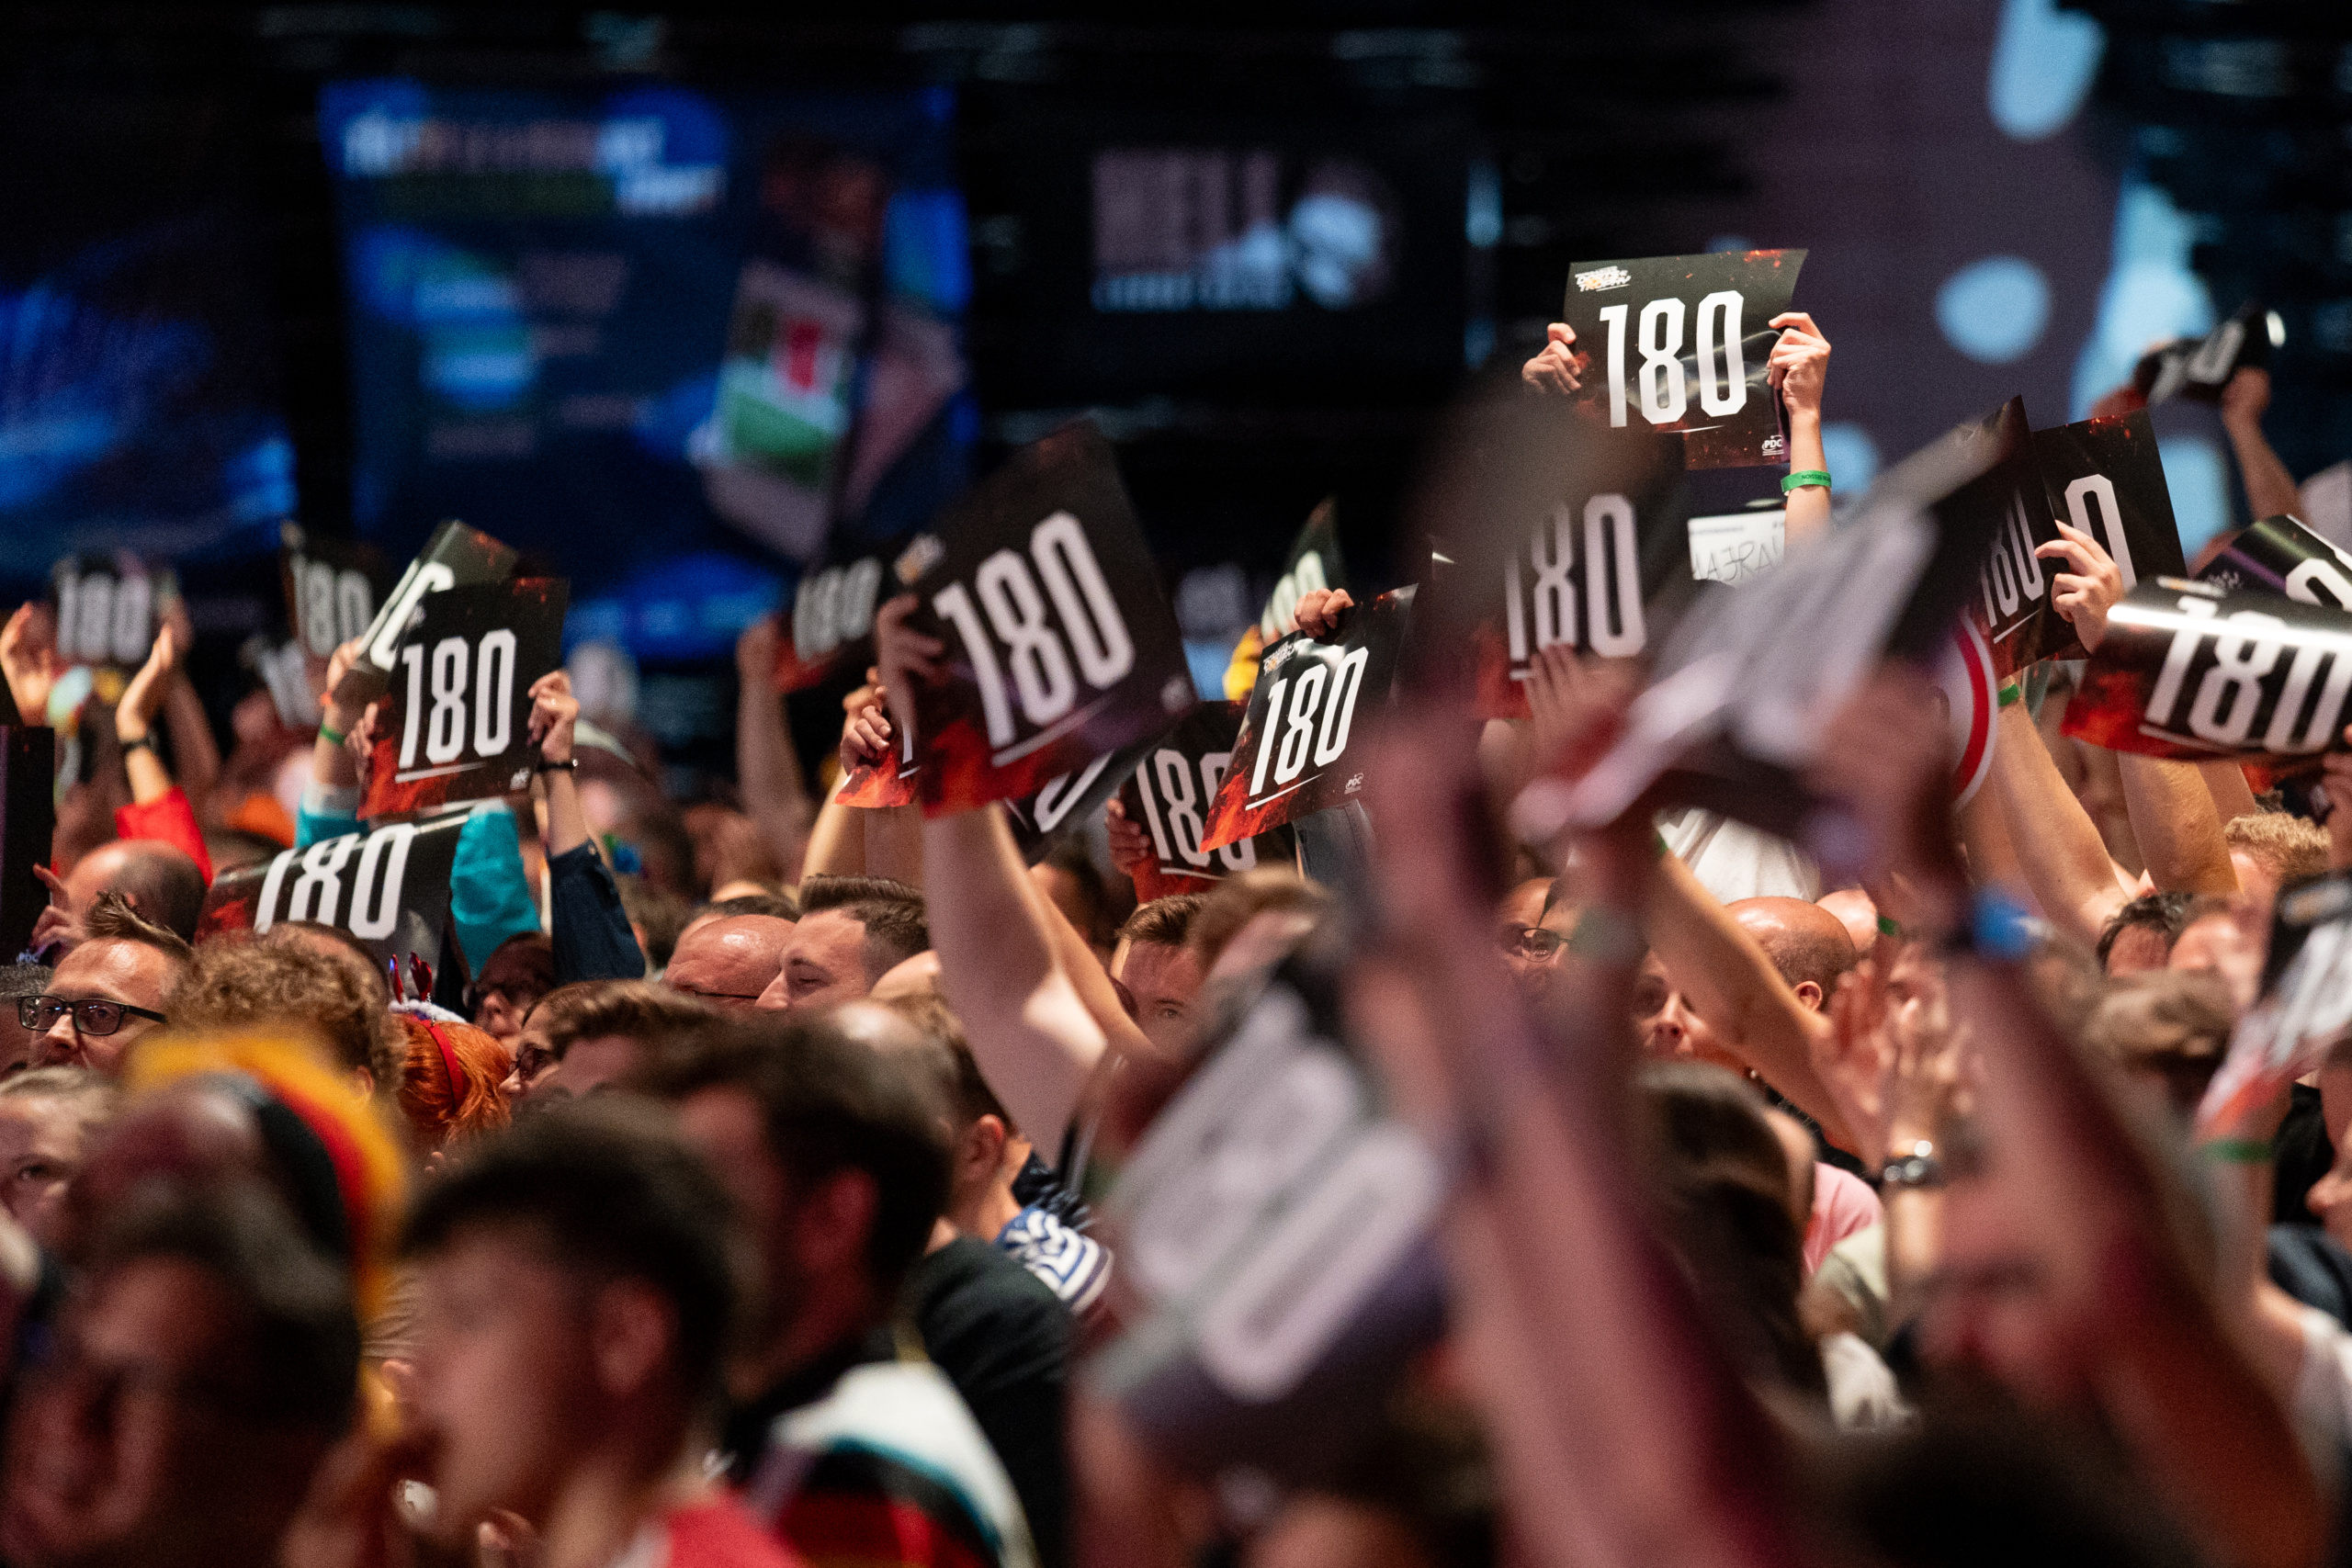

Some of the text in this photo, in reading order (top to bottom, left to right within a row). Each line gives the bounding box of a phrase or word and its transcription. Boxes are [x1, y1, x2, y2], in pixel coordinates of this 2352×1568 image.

[1600, 290, 1747, 428] 180
[1764, 438, 1783, 448] PDC
[933, 511, 1134, 750] 180
[1505, 492, 1647, 661] 180
[398, 628, 516, 769] 180
[1250, 646, 1369, 796] 180
[2144, 595, 2352, 753] 180
[254, 823, 415, 940] 180
